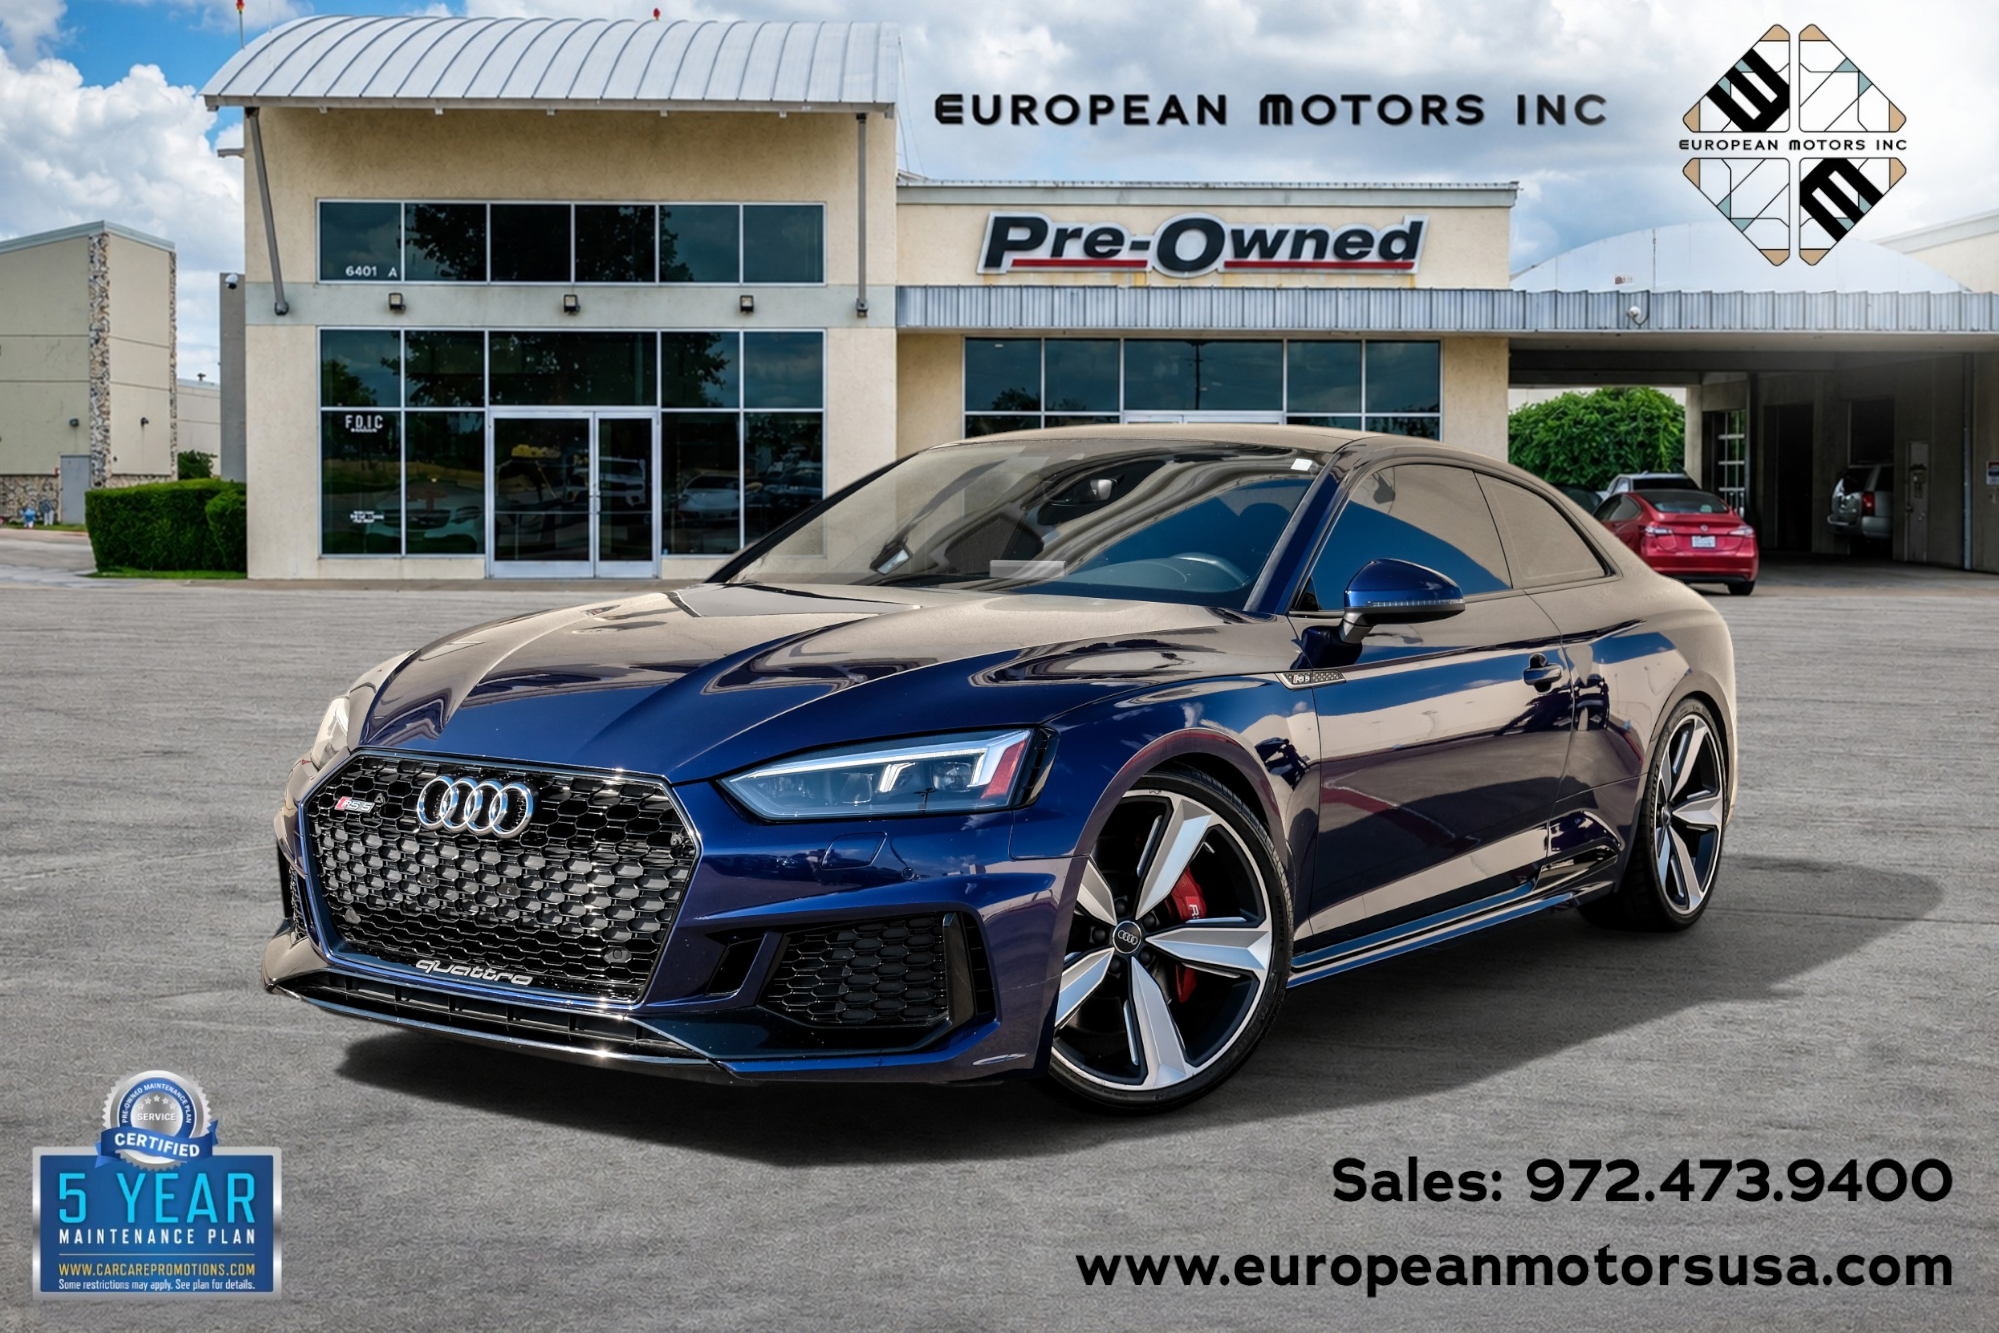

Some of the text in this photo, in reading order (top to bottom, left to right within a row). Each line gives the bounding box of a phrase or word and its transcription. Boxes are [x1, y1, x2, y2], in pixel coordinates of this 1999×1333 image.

[984, 216, 1424, 275] Pre-Owned
[345, 264, 398, 278] 6401 A
[415, 959, 533, 986] quattro
